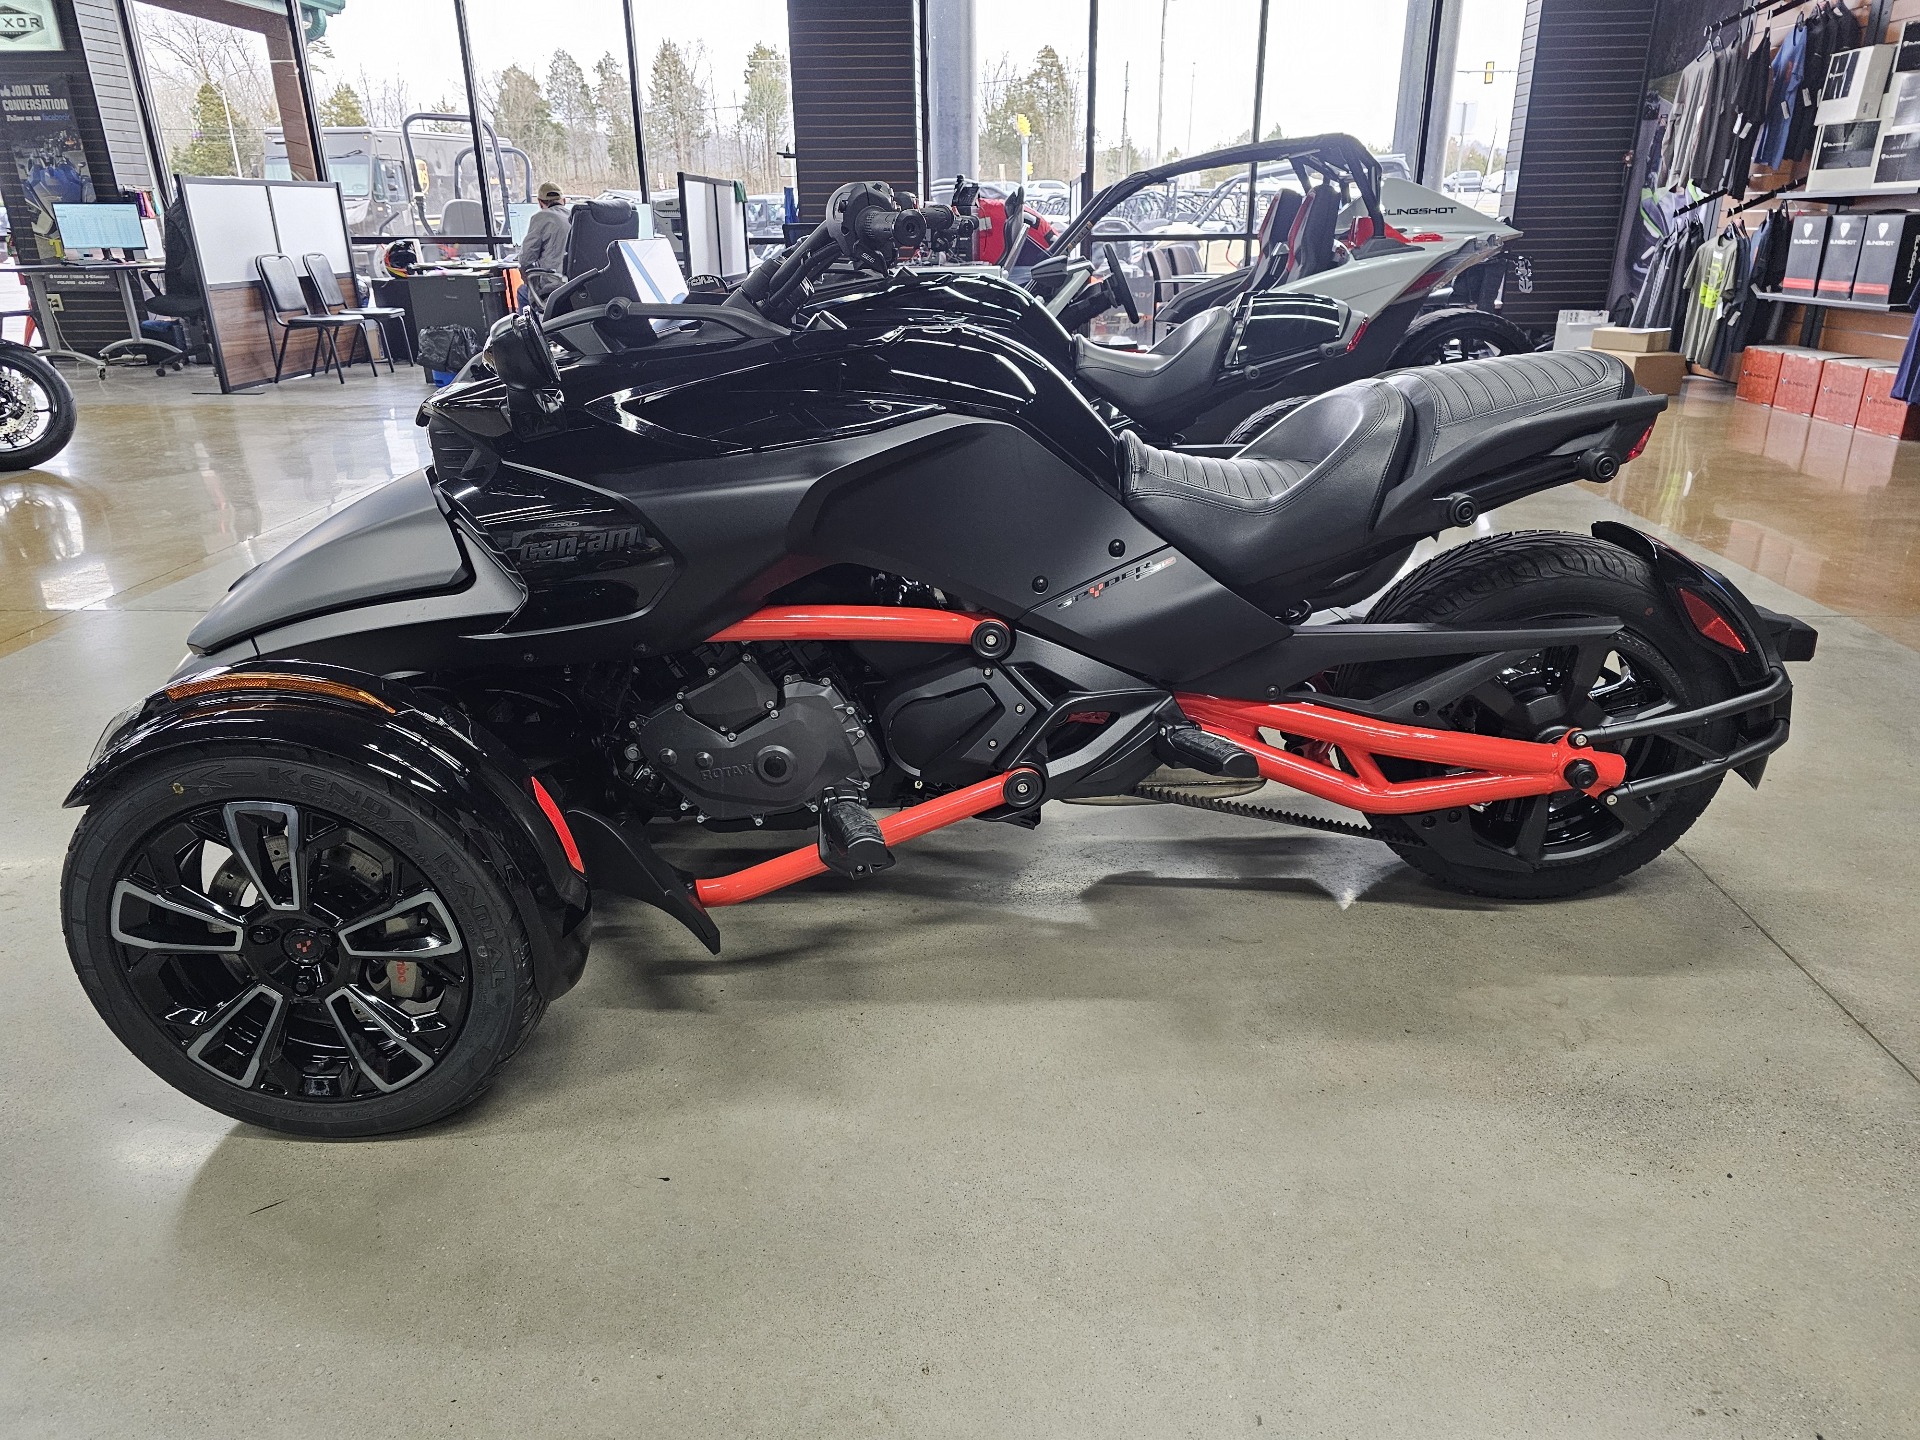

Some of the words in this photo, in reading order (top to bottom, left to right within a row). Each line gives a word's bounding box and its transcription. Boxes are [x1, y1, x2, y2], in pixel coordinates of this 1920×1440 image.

[11, 84, 32, 96] JOIN
[32, 84, 51, 96] THE
[2, 98, 68, 111] CONVERSATION
[42, 113, 70, 121] facebook
[1057, 560, 1152, 611] SPYDER
[700, 763, 755, 780] ROTAX
[268, 766, 420, 844] KENDA
[432, 850, 507, 989] RADIAL
